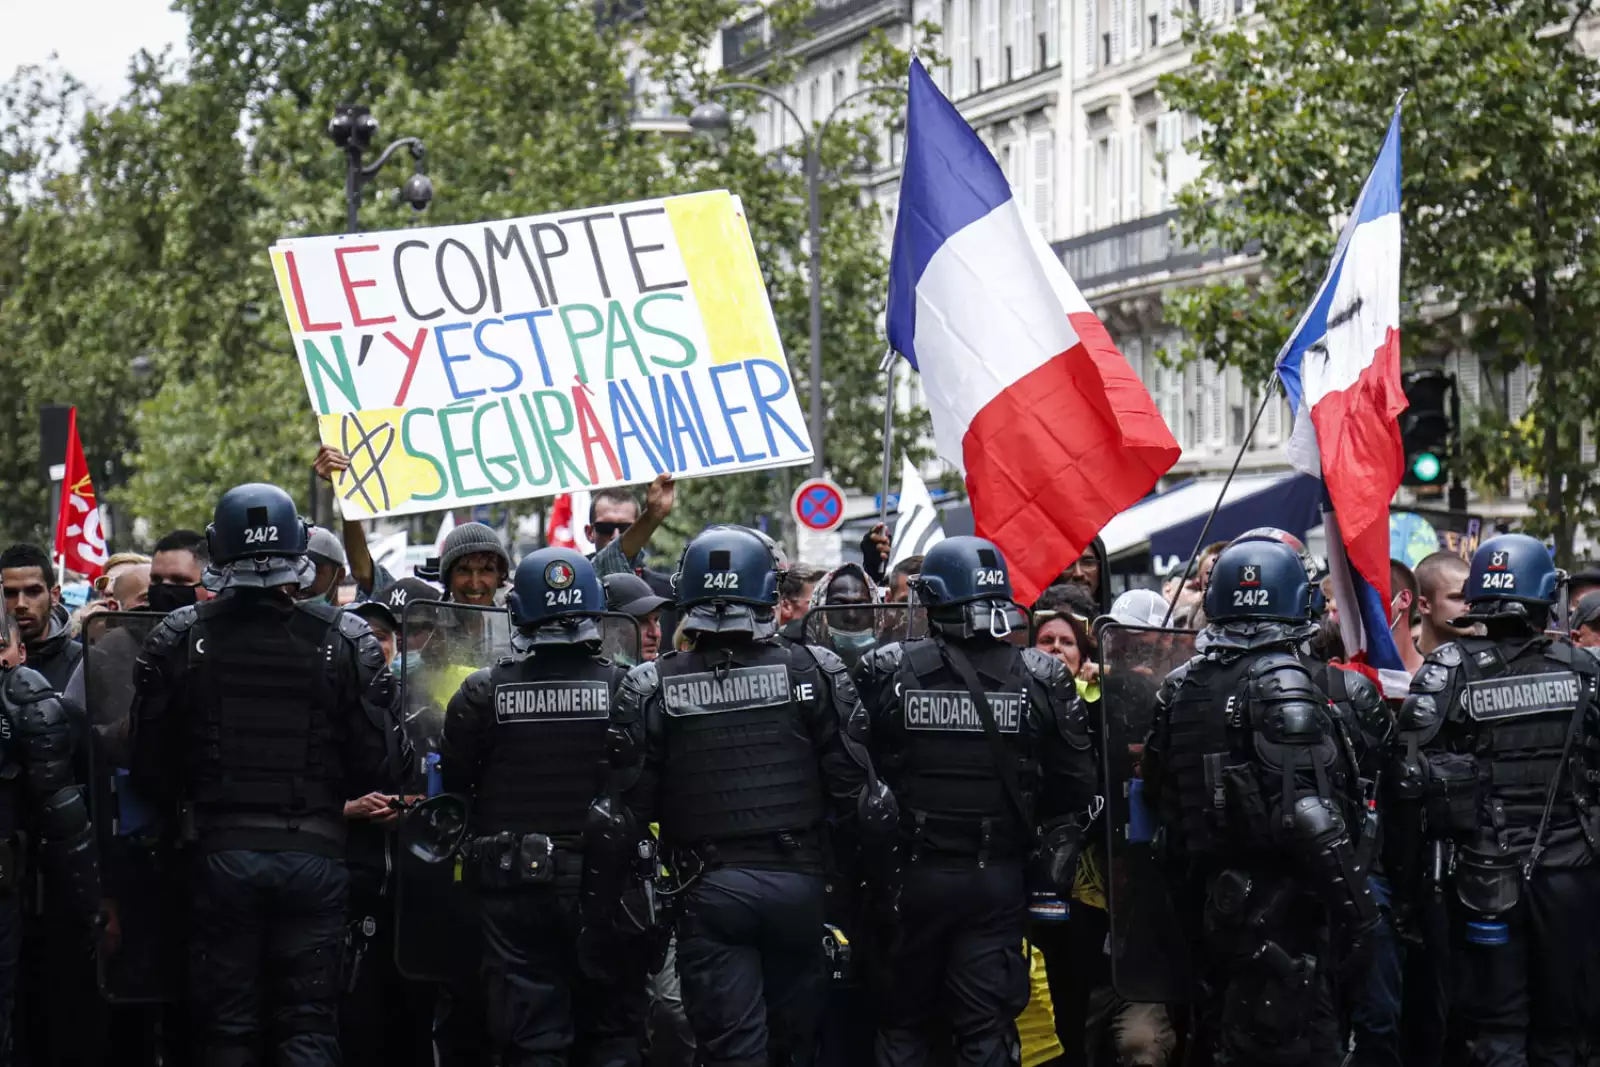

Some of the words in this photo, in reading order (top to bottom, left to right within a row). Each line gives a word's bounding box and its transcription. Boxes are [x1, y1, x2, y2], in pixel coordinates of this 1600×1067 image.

[284, 244, 397, 332] LE
[393, 207, 688, 321] COMPTE
[302, 328, 428, 415] N'Y
[433, 309, 554, 399] EST
[558, 292, 697, 384] PAS
[401, 390, 591, 501] SÉGUR
[571, 374, 624, 485] À
[607, 358, 810, 481] AVALER
[244, 526, 279, 544] 24/2
[703, 572, 739, 589] 24/2
[976, 570, 1005, 586] 24/2
[1482, 572, 1515, 589] 24/2
[545, 588, 583, 606] 24/2
[1233, 589, 1269, 606] 24/2
[667, 672, 788, 708] GENDARMERIE
[1472, 679, 1580, 713] GENDARMERIE
[497, 688, 608, 715] GENDARMERIE
